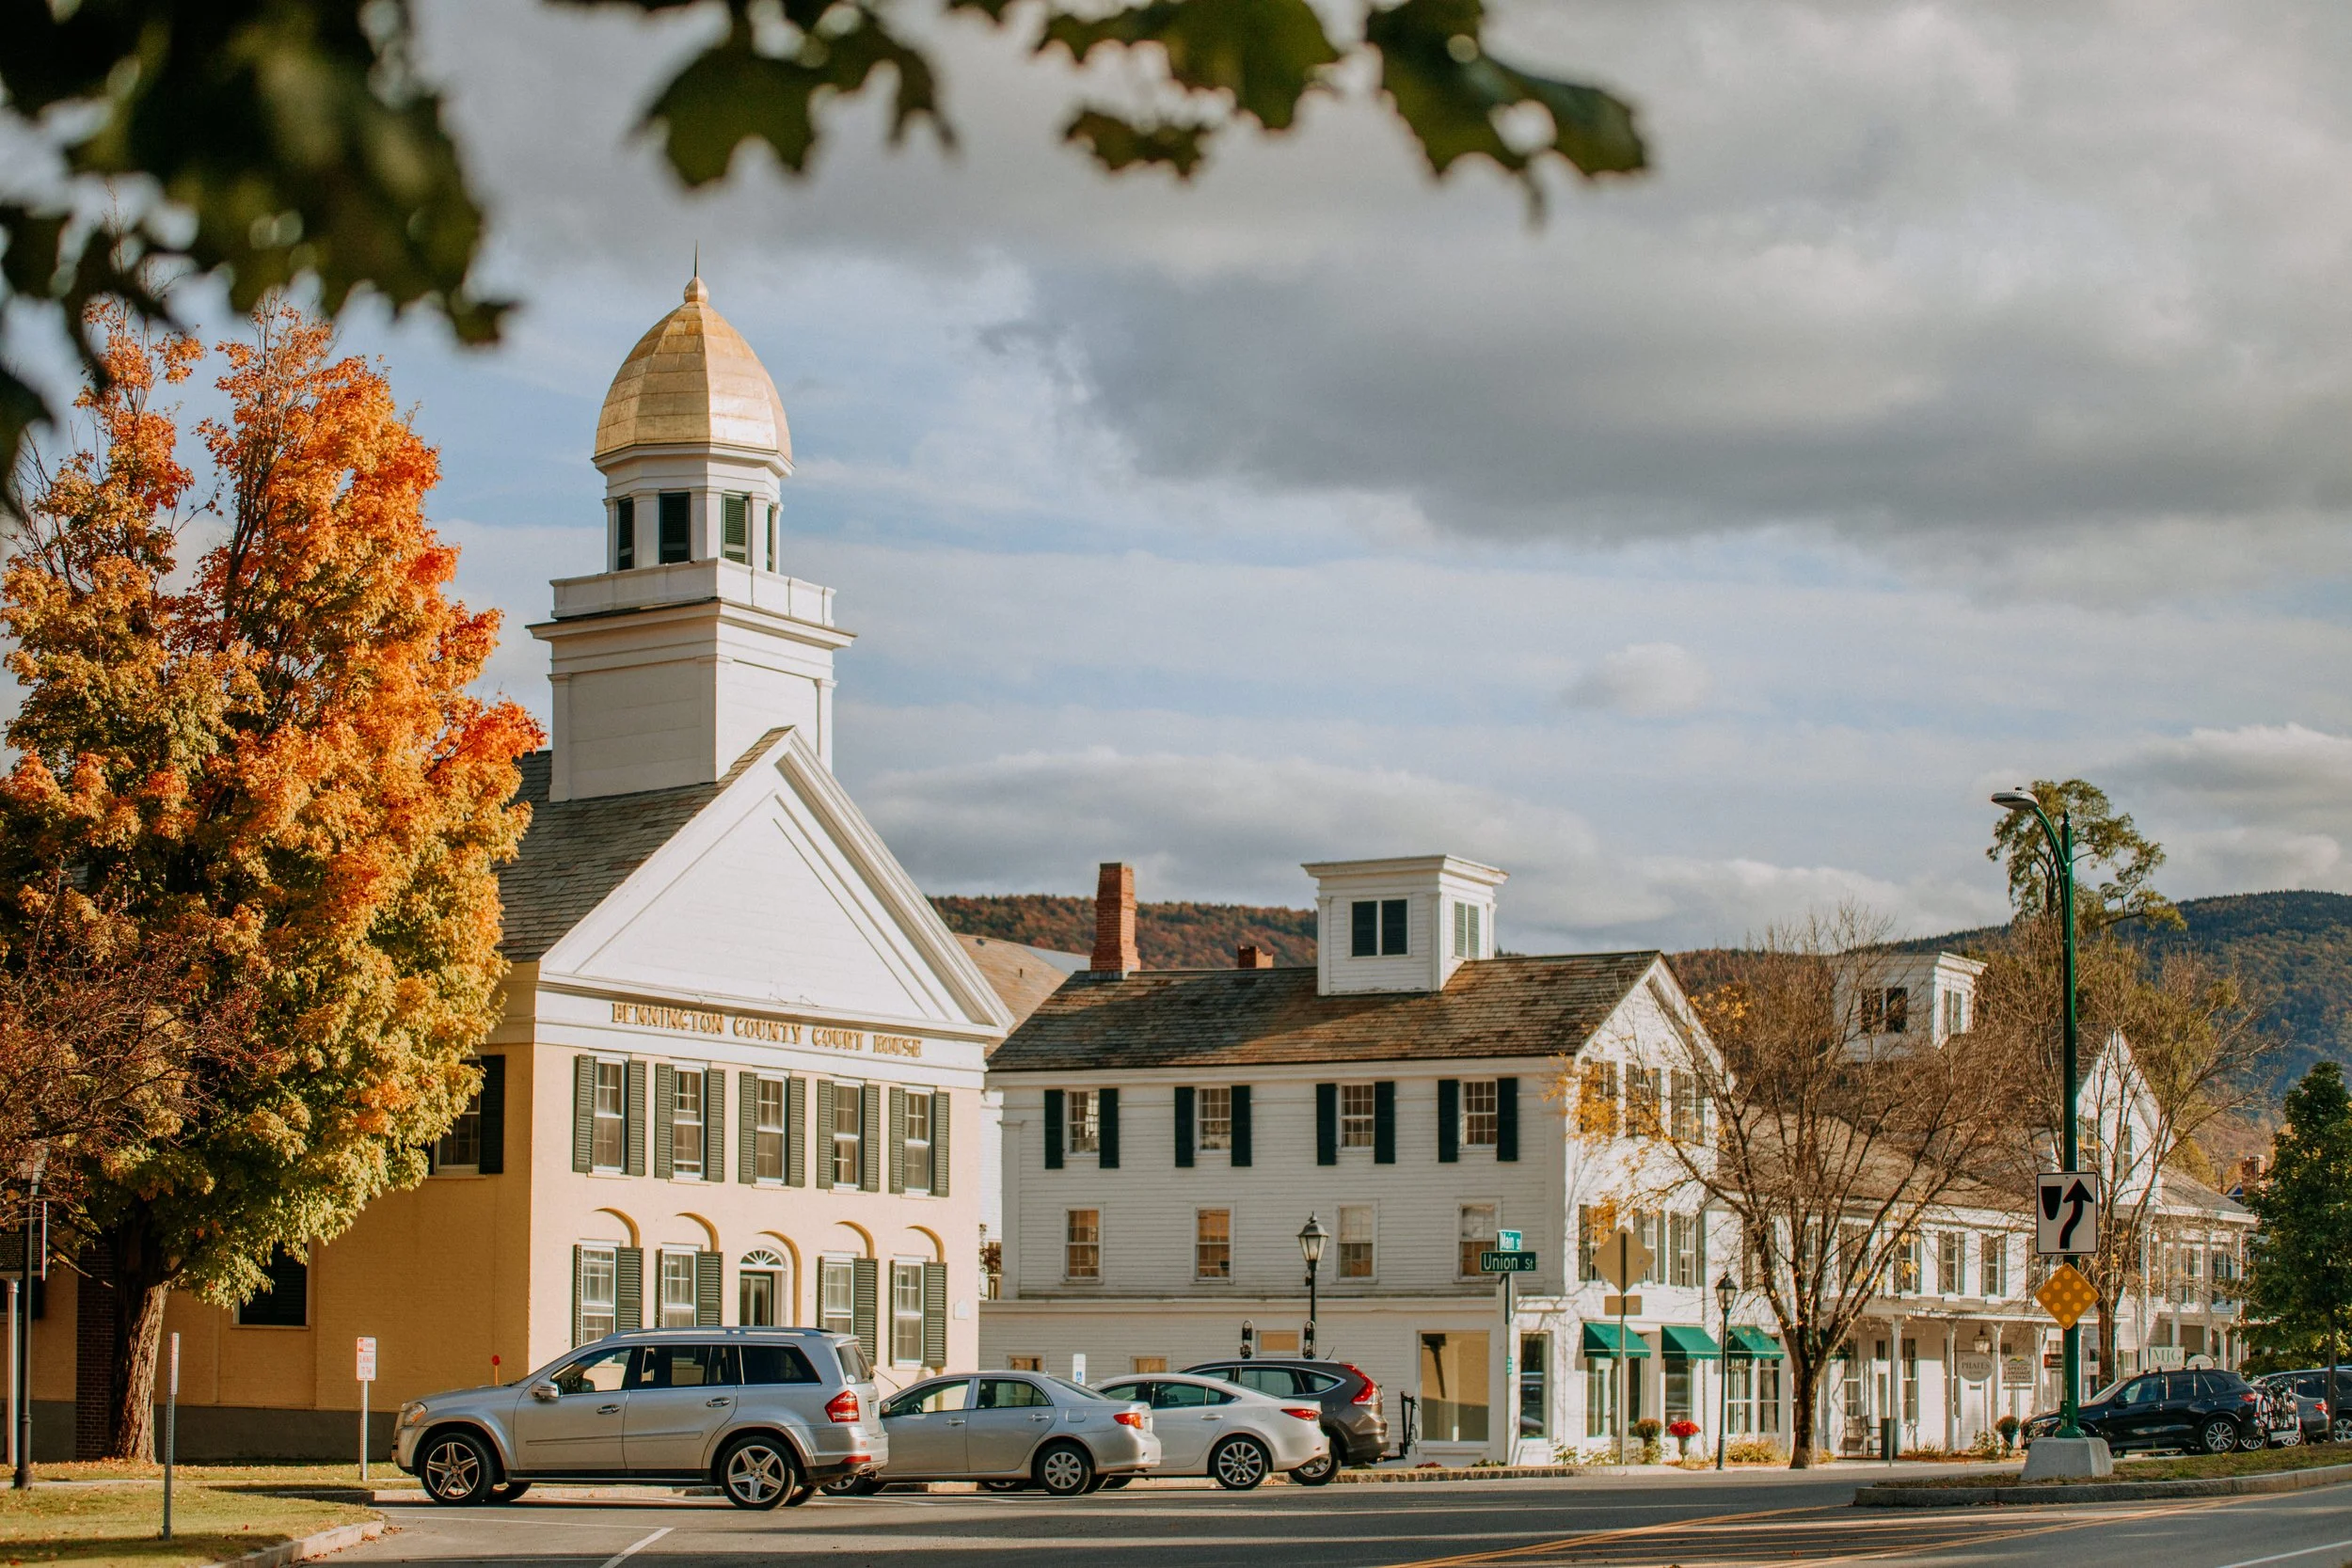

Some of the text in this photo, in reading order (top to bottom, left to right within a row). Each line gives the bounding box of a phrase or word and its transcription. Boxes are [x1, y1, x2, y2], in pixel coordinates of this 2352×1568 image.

[612, 1003, 923, 1058] BENNINGTON COUNTY COURT HOUSE
[1501, 1232, 1515, 1250] Main
[1484, 1253, 1534, 1270] Union St
[2153, 1349, 2181, 1363] MJG
[1962, 1361, 1990, 1370] PILATES
